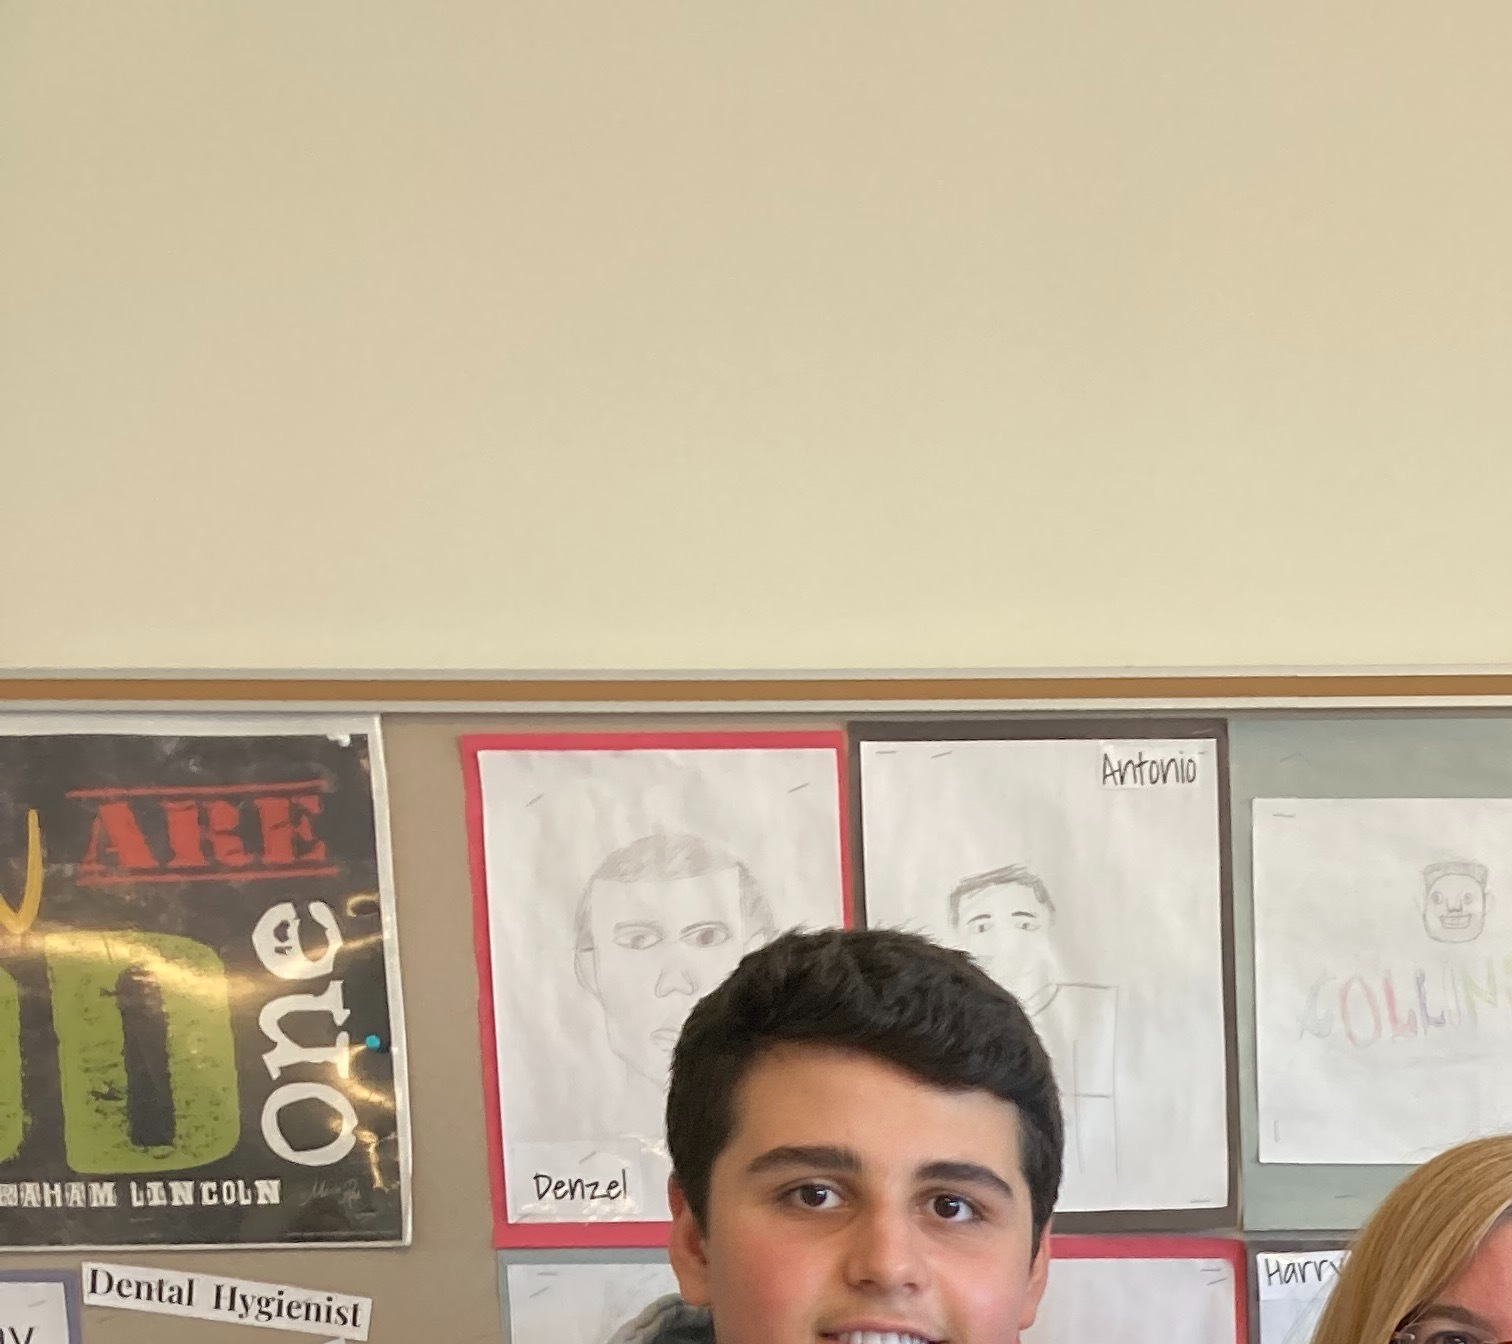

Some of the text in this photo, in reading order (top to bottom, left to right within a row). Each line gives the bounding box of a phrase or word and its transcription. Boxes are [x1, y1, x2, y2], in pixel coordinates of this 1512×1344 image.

[1102, 751, 1198, 786] Antonio
[79, 794, 327, 873] ARE
[252, 900, 359, 1166] one
[130, 1179, 281, 1207] LINCOLN
[533, 1169, 629, 1200] Denzel
[88, 1269, 361, 1327] Dental Hygienist
